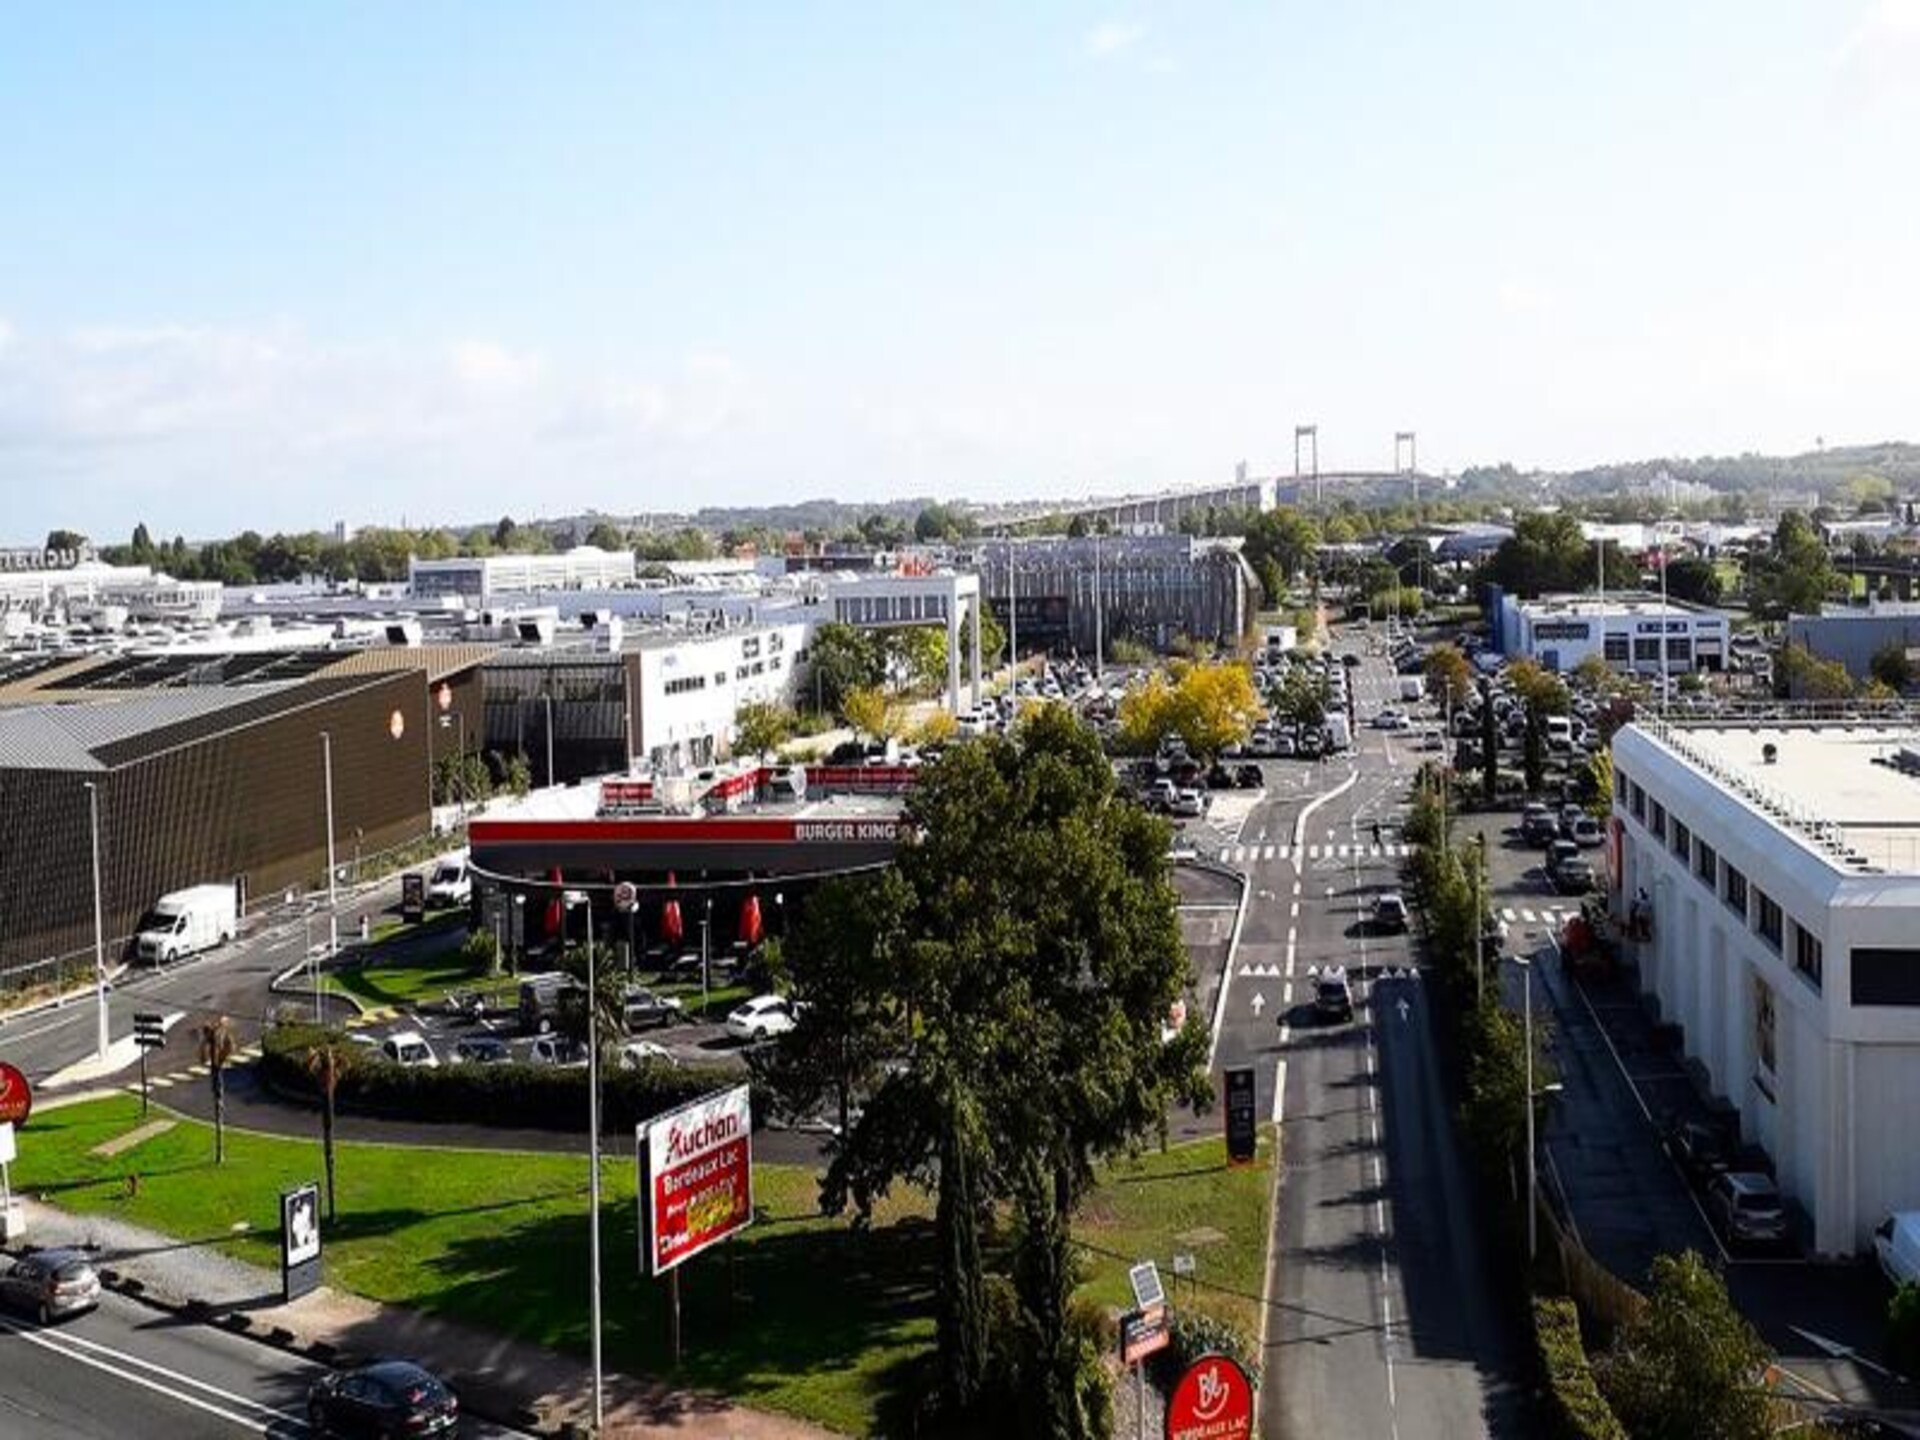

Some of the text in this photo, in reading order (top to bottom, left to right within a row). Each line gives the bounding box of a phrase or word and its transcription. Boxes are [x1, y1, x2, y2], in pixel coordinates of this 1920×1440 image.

[795, 823, 896, 840] BURGER KING
[667, 1113, 737, 1164] Auchan
[664, 1159, 718, 1196] Bordeaux
[720, 1149, 738, 1169] Lac
[1228, 1416, 1247, 1432] LAC
